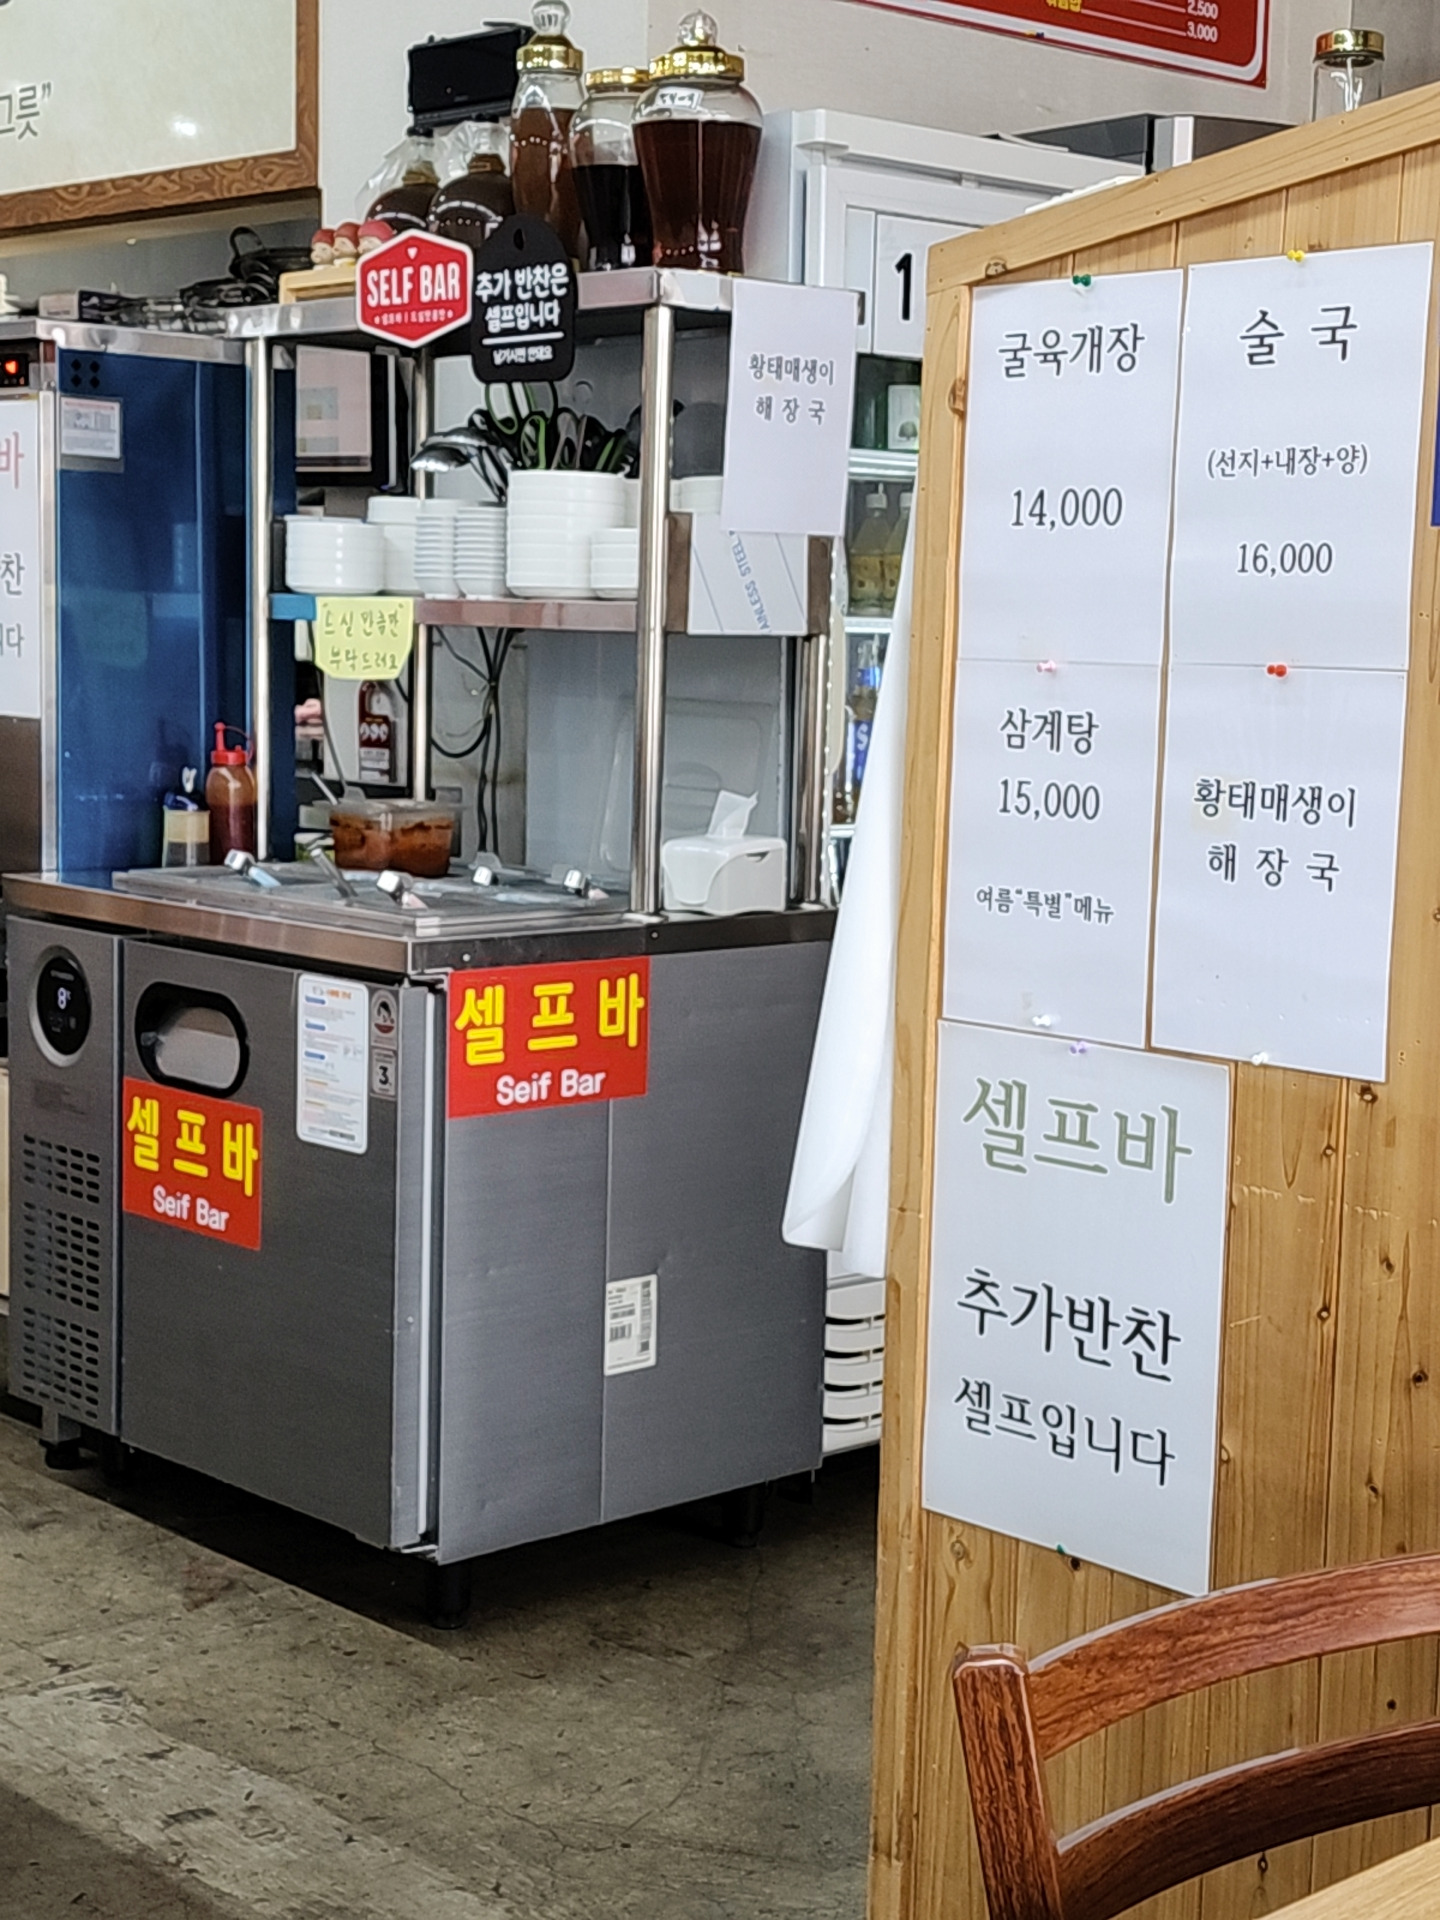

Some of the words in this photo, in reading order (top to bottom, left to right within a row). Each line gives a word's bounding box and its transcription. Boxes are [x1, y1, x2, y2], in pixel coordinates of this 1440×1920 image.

[366, 265, 414, 307] SELF
[419, 262, 461, 303] BAR
[475, 268, 511, 304] 추가
[513, 261, 570, 301] 반찬은
[895, 253, 912, 321] 1
[484, 299, 561, 334] 셀프입니다
[749, 353, 834, 386] 황태매생이
[998, 322, 1146, 379] 굴육개장
[1207, 444, 1368, 479] (선지+내장+양)
[1011, 487, 1123, 531] 14,000
[1237, 542, 1333, 577] 16,000
[1000, 707, 1100, 755] 삼계탕
[998, 778, 1100, 821] 15,000
[1193, 778, 1356, 828] 황태매생이
[379, 1065, 390, 1085] 3
[560, 1068, 606, 1098] Bar
[962, 1077, 1193, 1204] 셀프바
[195, 1197, 230, 1232] Bar
[957, 1268, 1182, 1384] 추가반찬
[954, 1376, 1176, 1487] 셀프입니다
